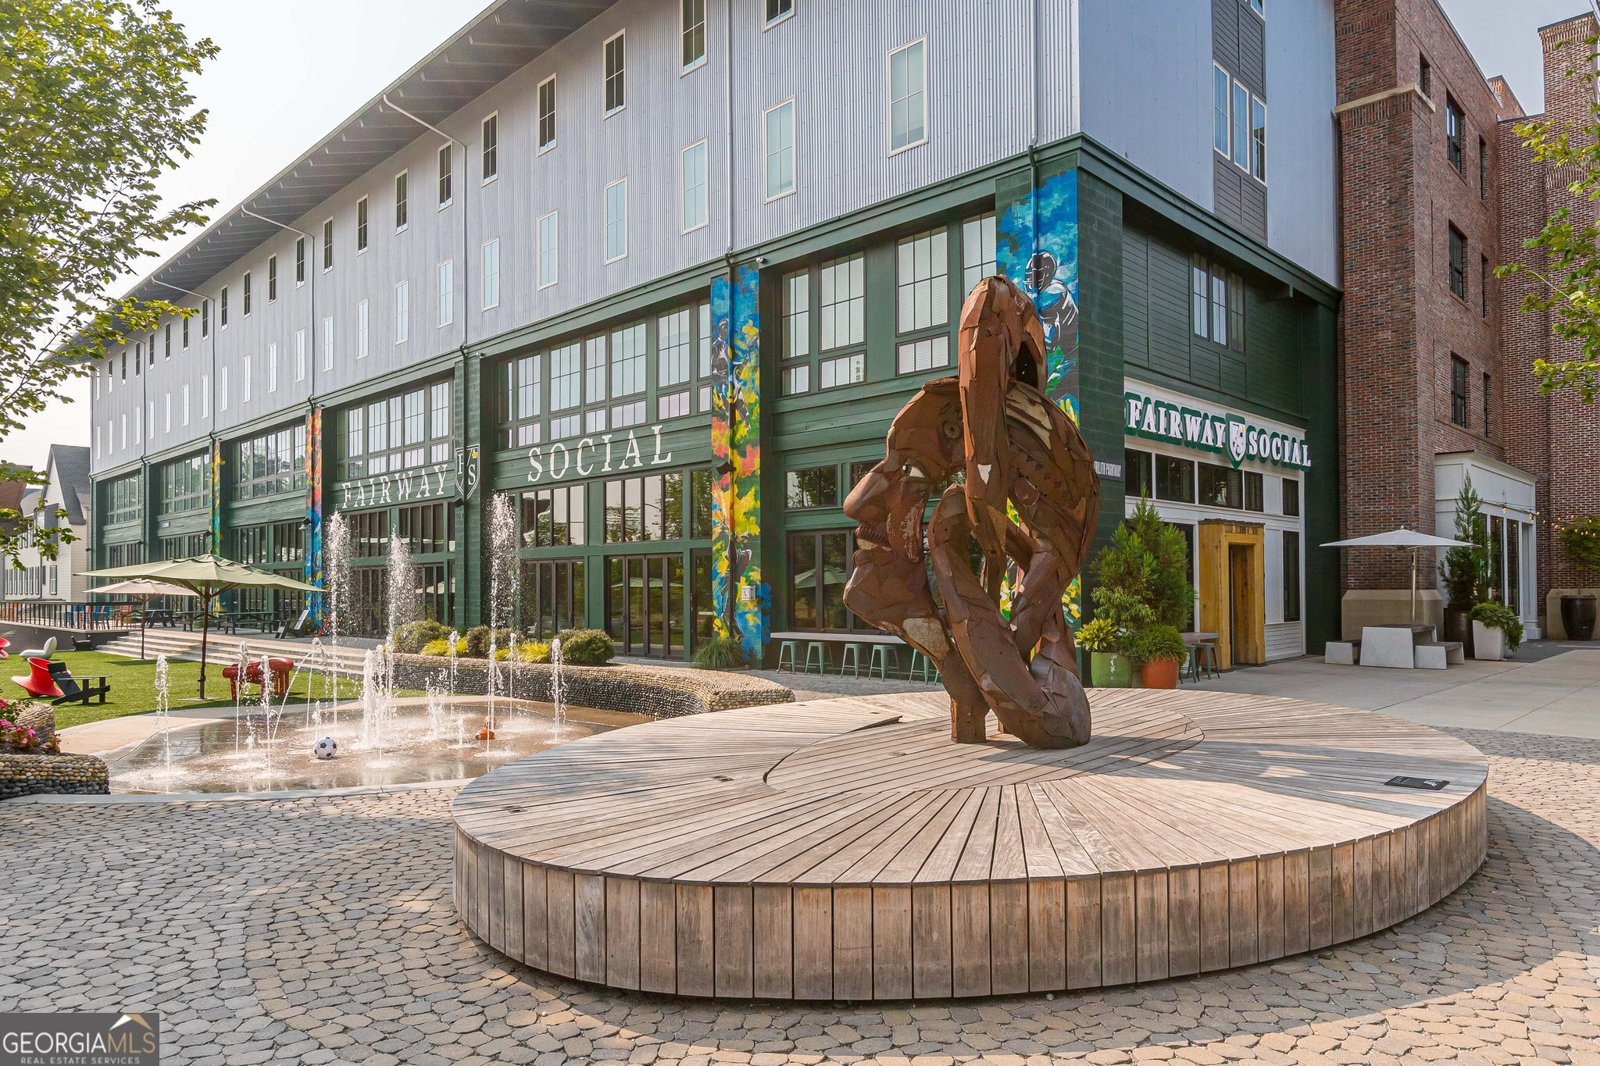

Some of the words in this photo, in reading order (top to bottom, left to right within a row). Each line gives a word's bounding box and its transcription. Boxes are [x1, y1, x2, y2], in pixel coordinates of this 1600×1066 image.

[341, 464, 448, 509] FAIRWAY
[527, 425, 672, 483] SOCIAL
[1127, 399, 1226, 448] FAIRWAY
[1248, 430, 1312, 467] SOCIAL
